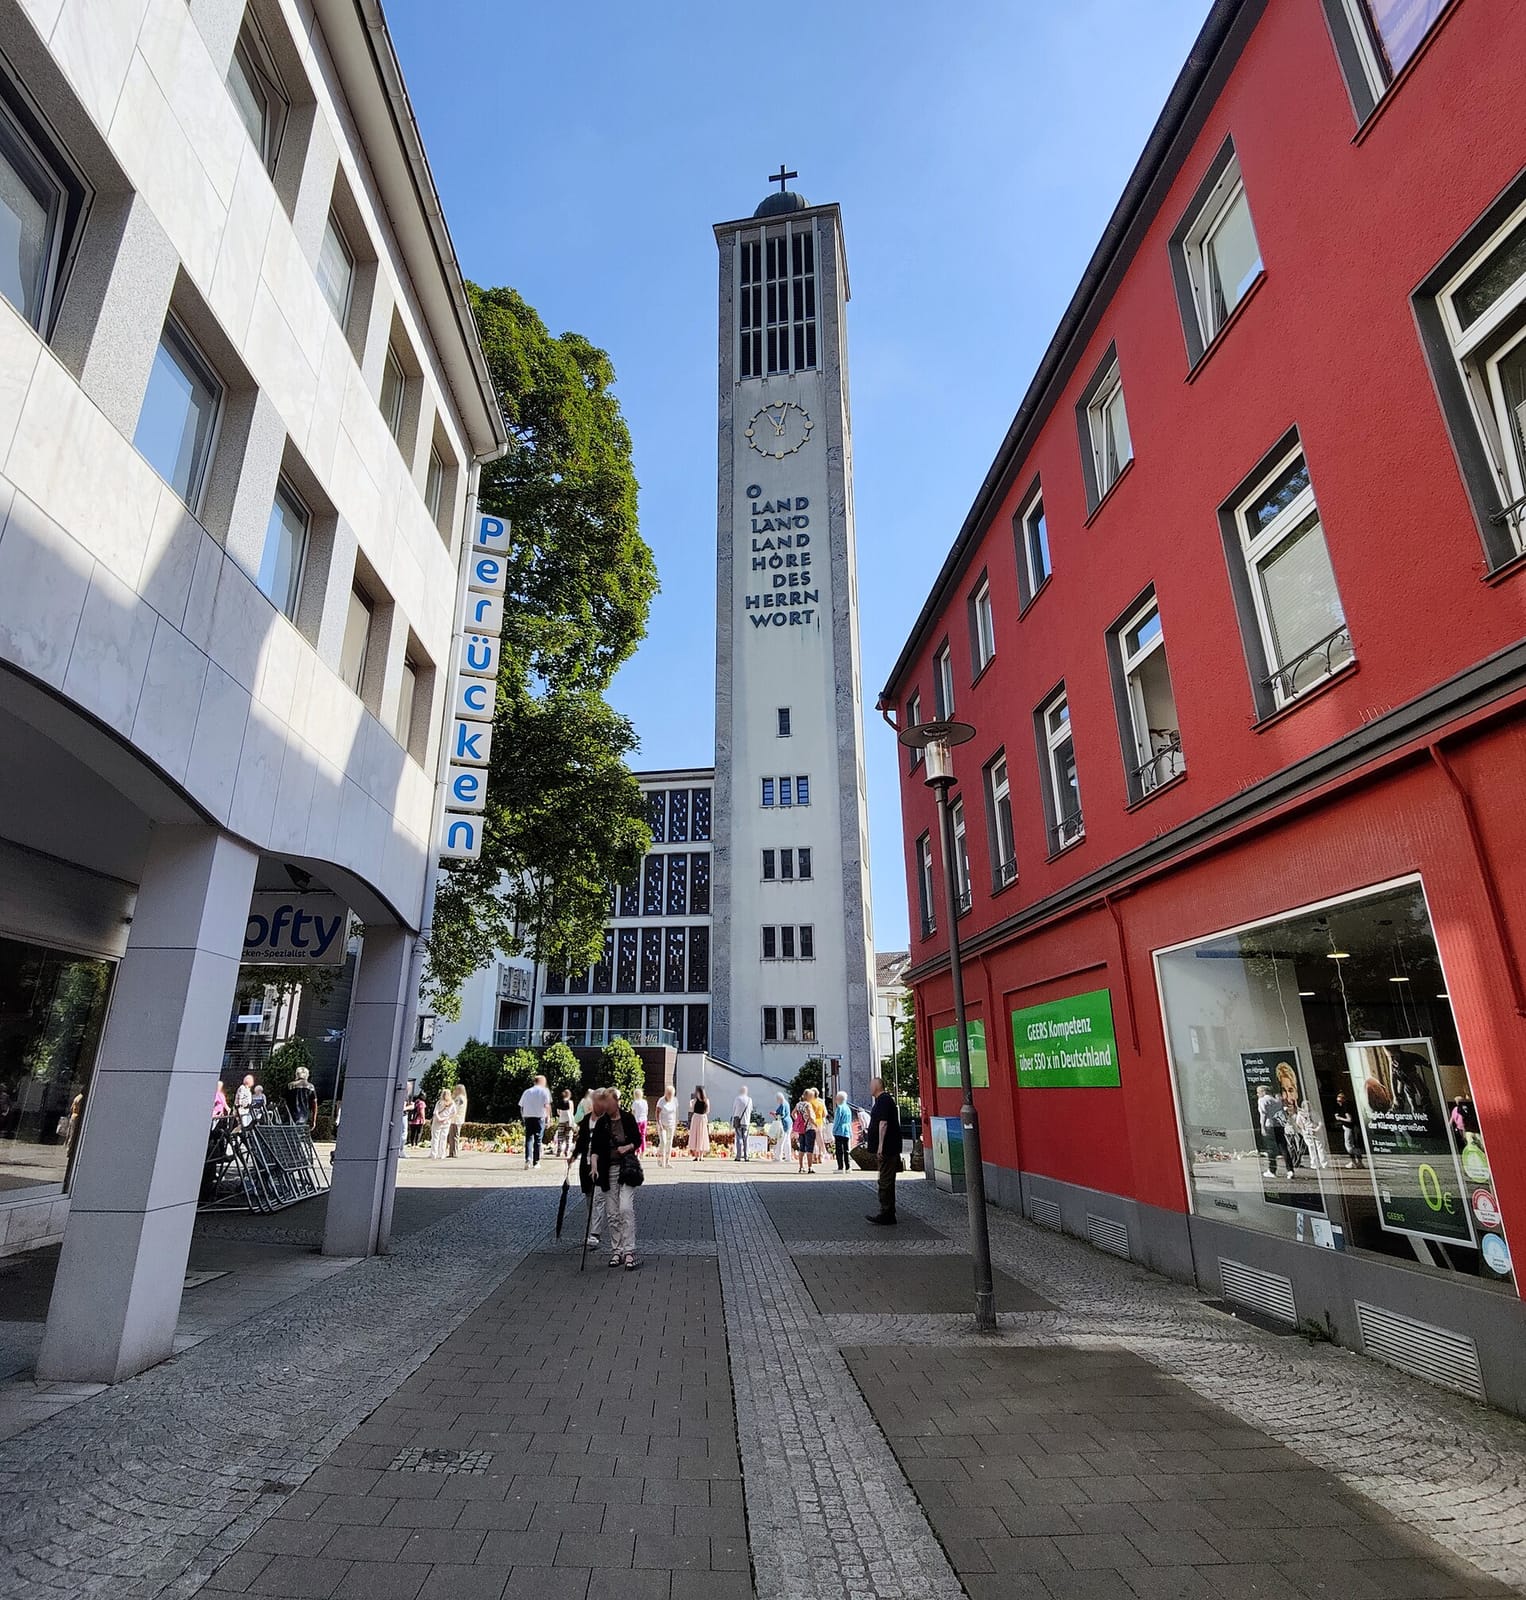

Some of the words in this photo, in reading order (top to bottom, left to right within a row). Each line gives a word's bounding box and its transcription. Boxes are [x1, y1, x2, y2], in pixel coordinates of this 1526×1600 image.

[746, 484, 762, 499] O
[752, 496, 809, 515] LAND
[751, 515, 810, 534] LAND
[752, 534, 810, 552] LAND
[773, 571, 811, 588] DES
[746, 589, 819, 610] HERRN
[750, 610, 815, 628] WORT
[447, 517, 504, 850] Perücken
[1027, 1021, 1048, 1041] GEERS
[1048, 1016, 1092, 1041] Kompetenz
[1020, 1053, 1034, 1071] über
[1047, 1055, 1053, 1069] x
[1052, 1050, 1060, 1069] in
[1060, 1044, 1112, 1069] Deutschland
[1386, 1211, 1405, 1222] GEERS
